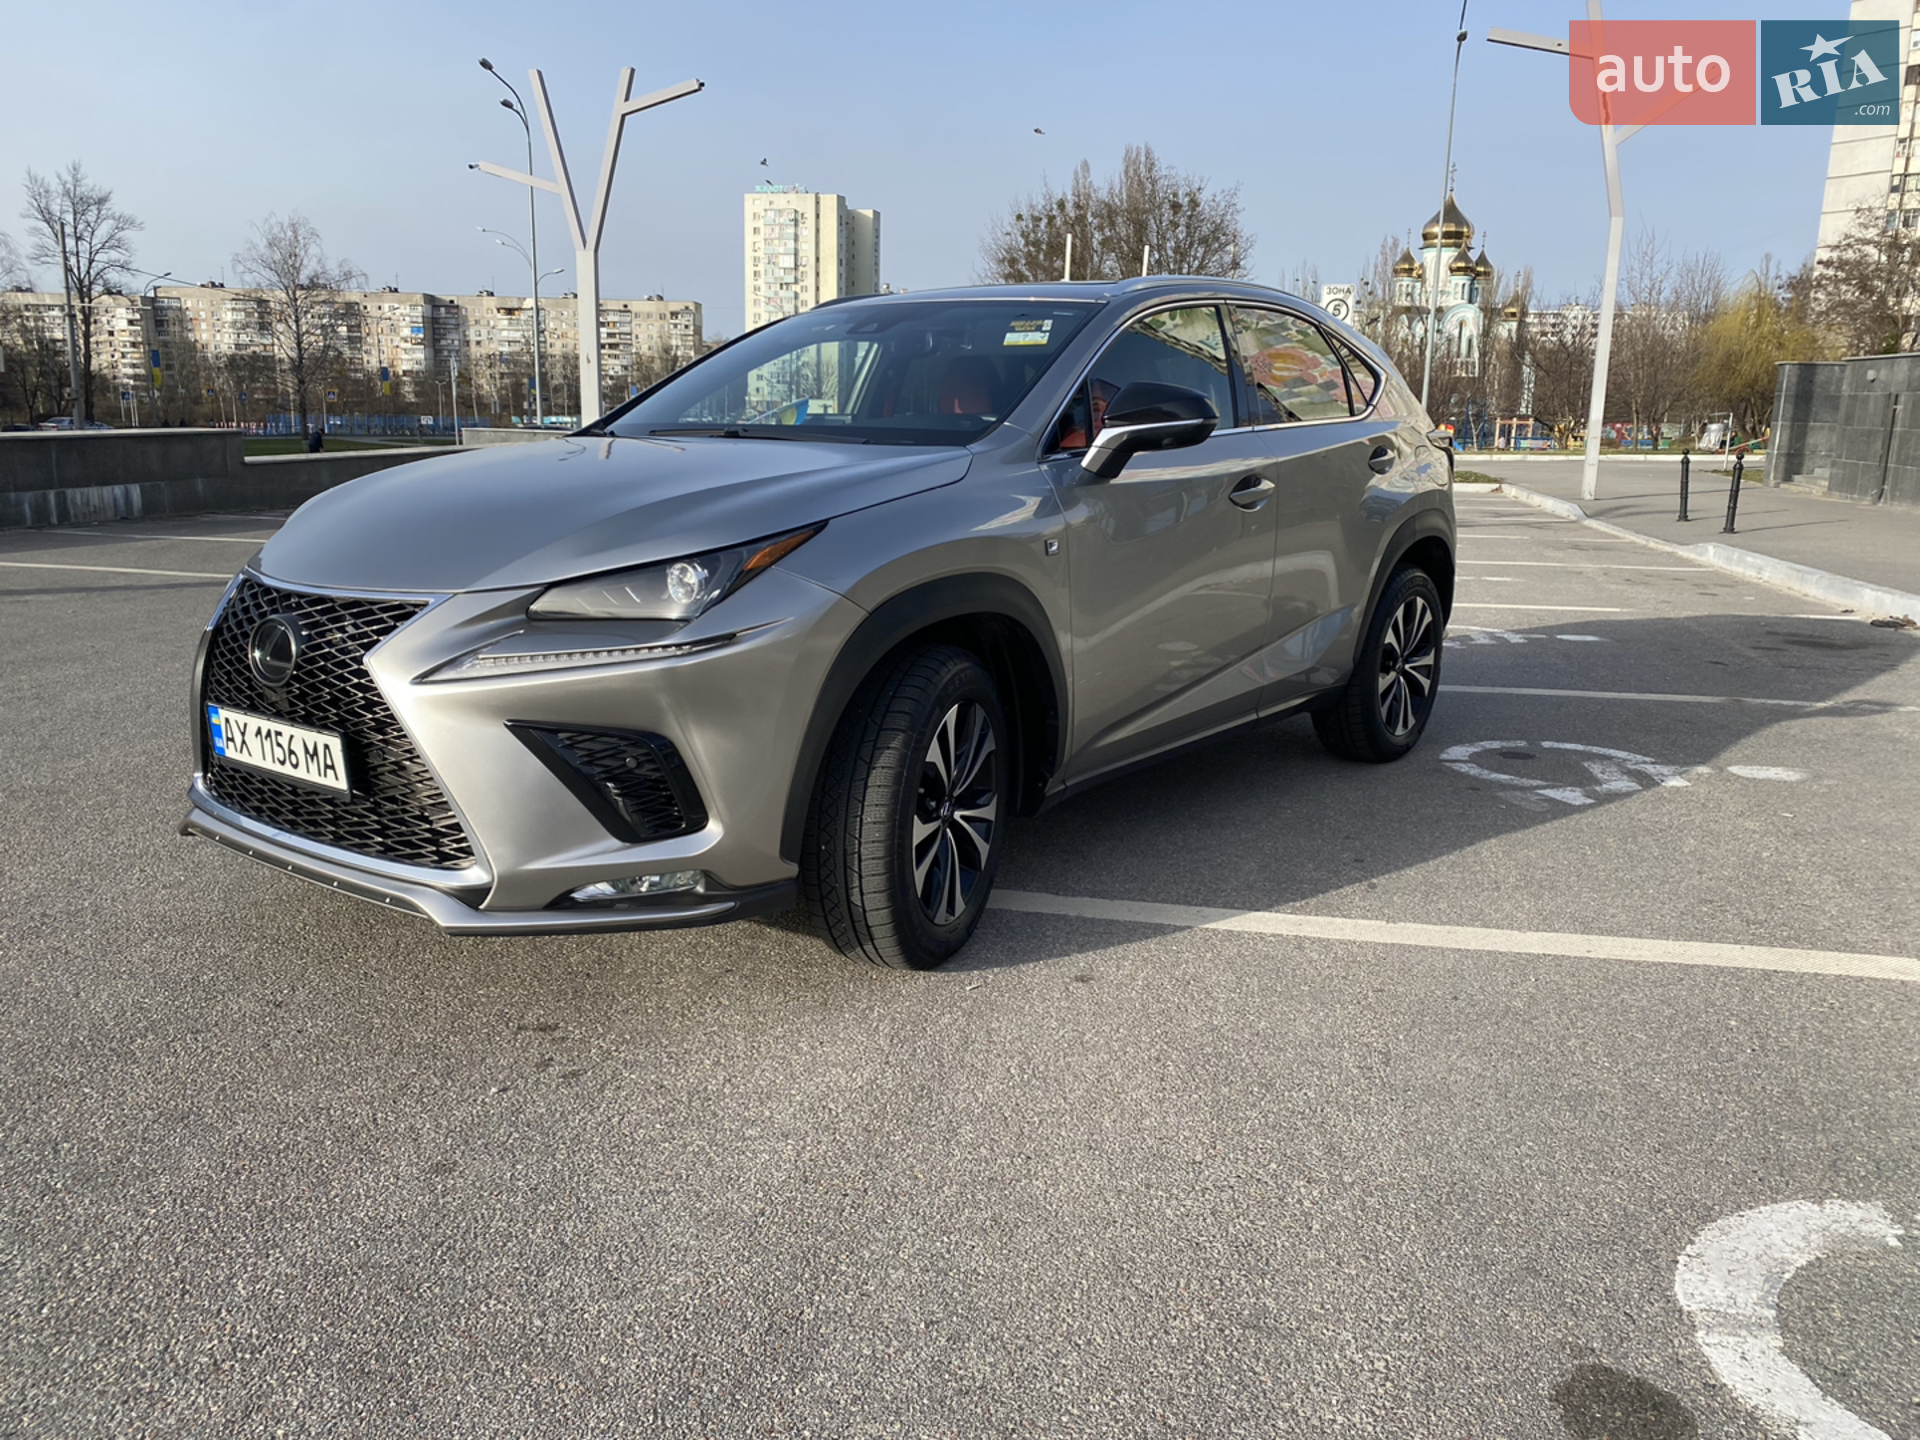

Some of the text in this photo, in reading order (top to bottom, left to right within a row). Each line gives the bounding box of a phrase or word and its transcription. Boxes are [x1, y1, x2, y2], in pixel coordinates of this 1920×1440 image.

[1326, 286, 1351, 296] ЗОНА
[1332, 303, 1341, 317] 5
[224, 717, 339, 781] AX 1156 MA
